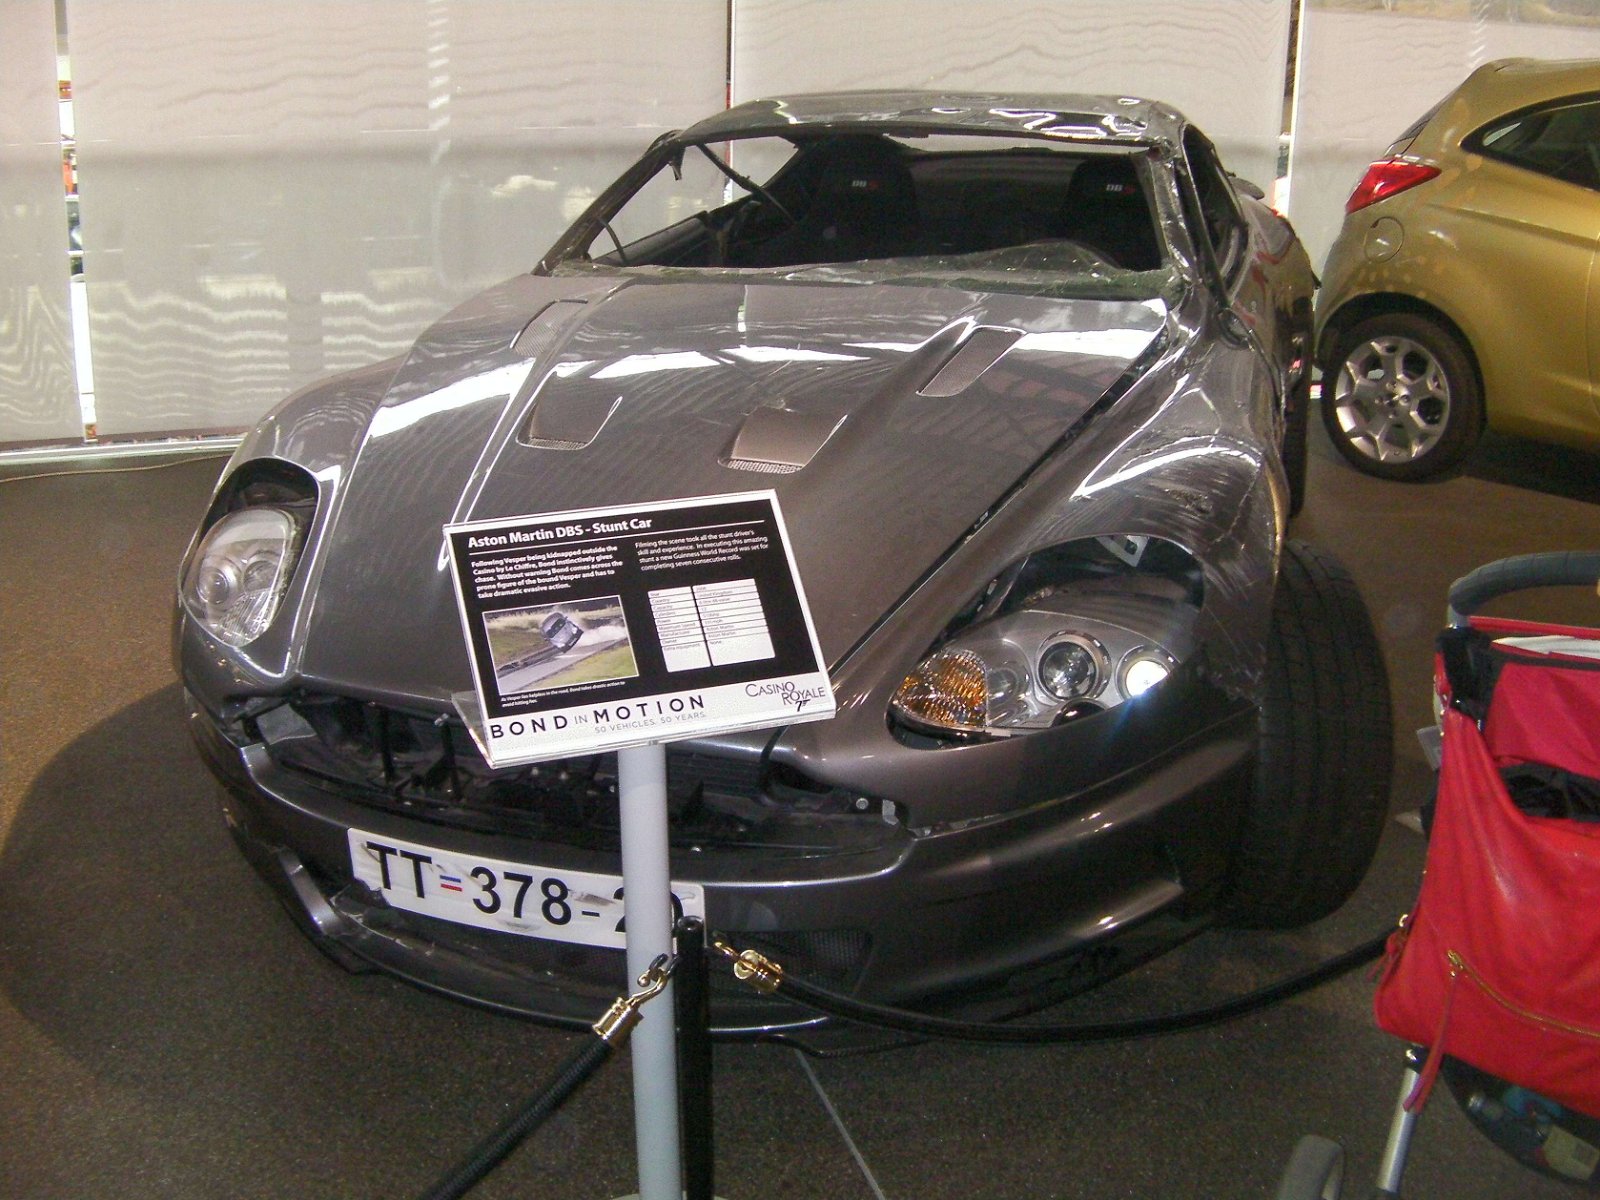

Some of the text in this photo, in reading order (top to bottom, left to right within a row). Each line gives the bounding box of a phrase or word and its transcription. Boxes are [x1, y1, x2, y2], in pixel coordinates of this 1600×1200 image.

[468, 536, 507, 548] Aston
[509, 529, 554, 544] Martin
[556, 526, 584, 538] DBS
[592, 521, 629, 534] Stunt
[630, 518, 652, 530] Car
[471, 559, 504, 568] Following
[546, 549, 581, 558] kidnapped
[556, 556, 595, 565] instinctively
[596, 554, 612, 562] gives
[641, 562, 674, 571] completing
[693, 556, 726, 564] consecutive
[745, 681, 795, 697] CASINO
[781, 687, 826, 705] ROYALE
[490, 694, 704, 738] BOND IN MOTION
[661, 716, 672, 724] 50
